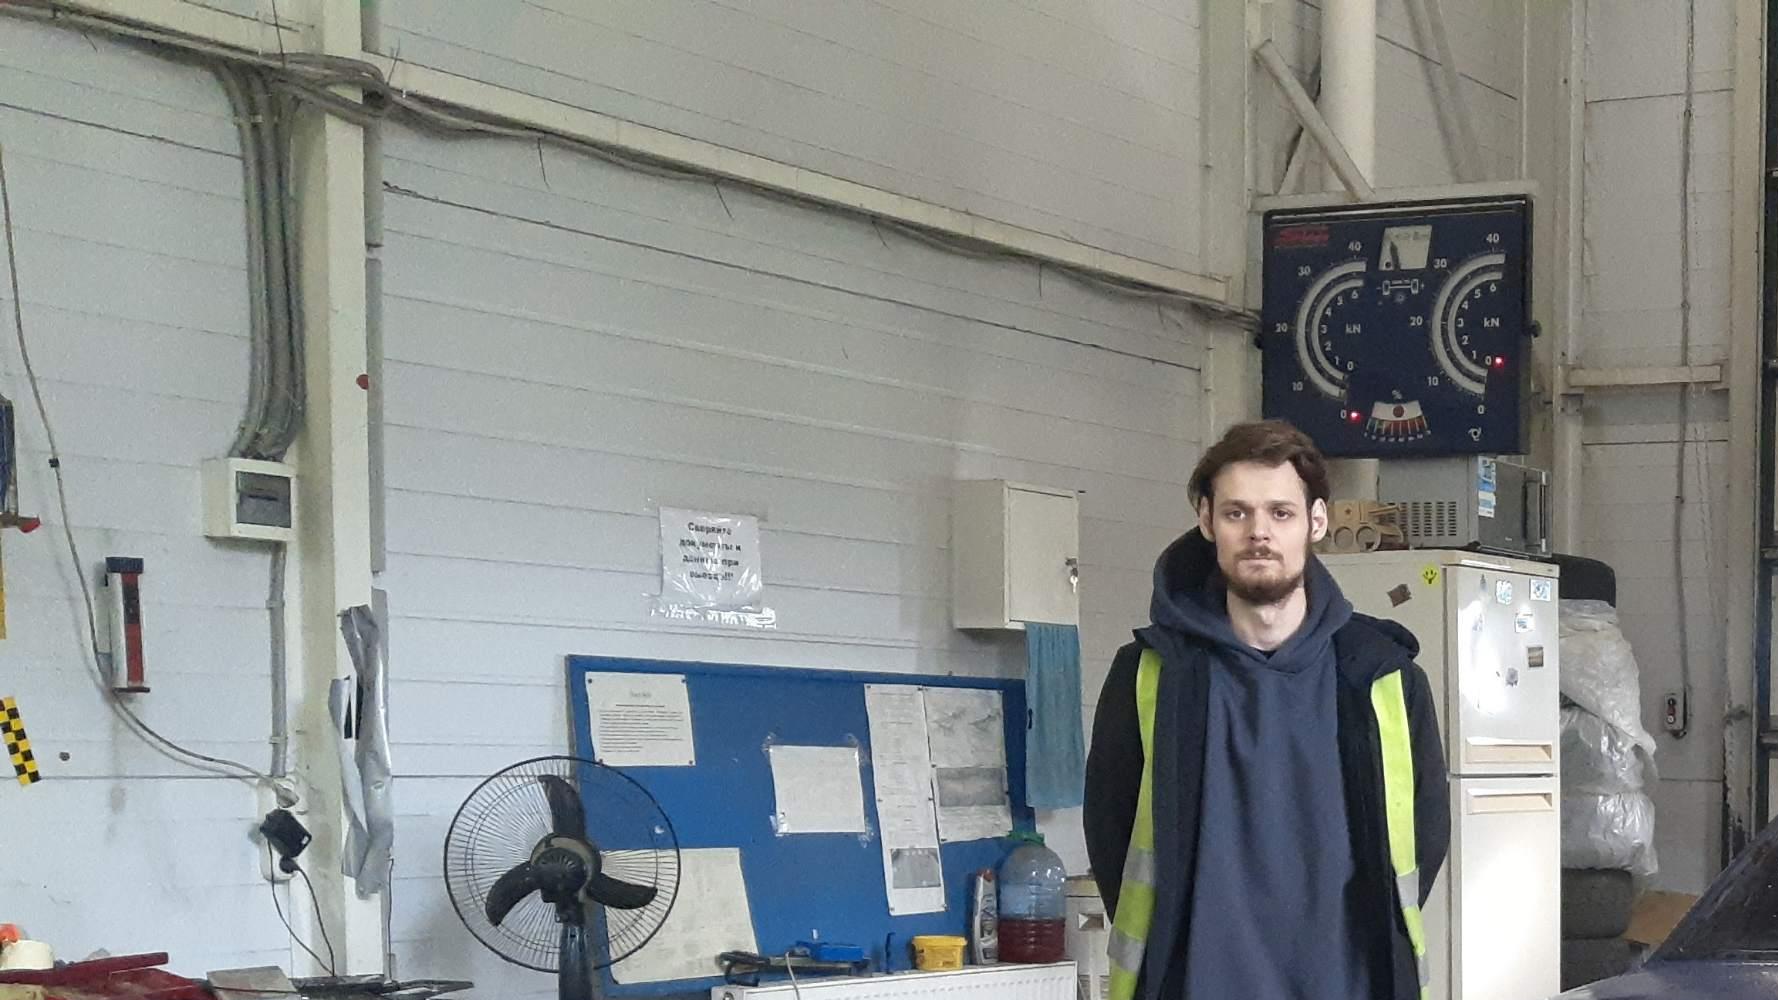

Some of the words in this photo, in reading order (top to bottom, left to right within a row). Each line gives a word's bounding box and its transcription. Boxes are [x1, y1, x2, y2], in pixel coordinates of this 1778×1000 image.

[1486, 233, 1500, 243] 40
[1348, 241, 1362, 252] 40
[1433, 258, 1447, 269] 30
[1297, 265, 1311, 276] 30
[1490, 283, 1497, 292] 6
[1351, 290, 1359, 300] 6
[1474, 288, 1481, 299] 5
[1461, 300, 1469, 310] 4
[1325, 307, 1332, 317] 4
[1409, 316, 1423, 326] 20
[1457, 318, 1464, 327] 3
[1483, 316, 1500, 328] kN
[1275, 322, 1288, 333] 20
[1320, 324, 1327, 334] 3
[1345, 323, 1361, 334] kN
[1461, 335, 1469, 345] 2
[1324, 341, 1332, 351] 2
[1471, 350, 1477, 360] 1
[1485, 355, 1492, 365] 0
[1334, 356, 1340, 366] 1
[1347, 360, 1354, 370] 0
[1292, 381, 1303, 391] 10
[1427, 376, 1439, 386] 10
[1340, 409, 1347, 419] 0
[1477, 405, 1485, 415] 0
[721, 559, 739, 567] при
